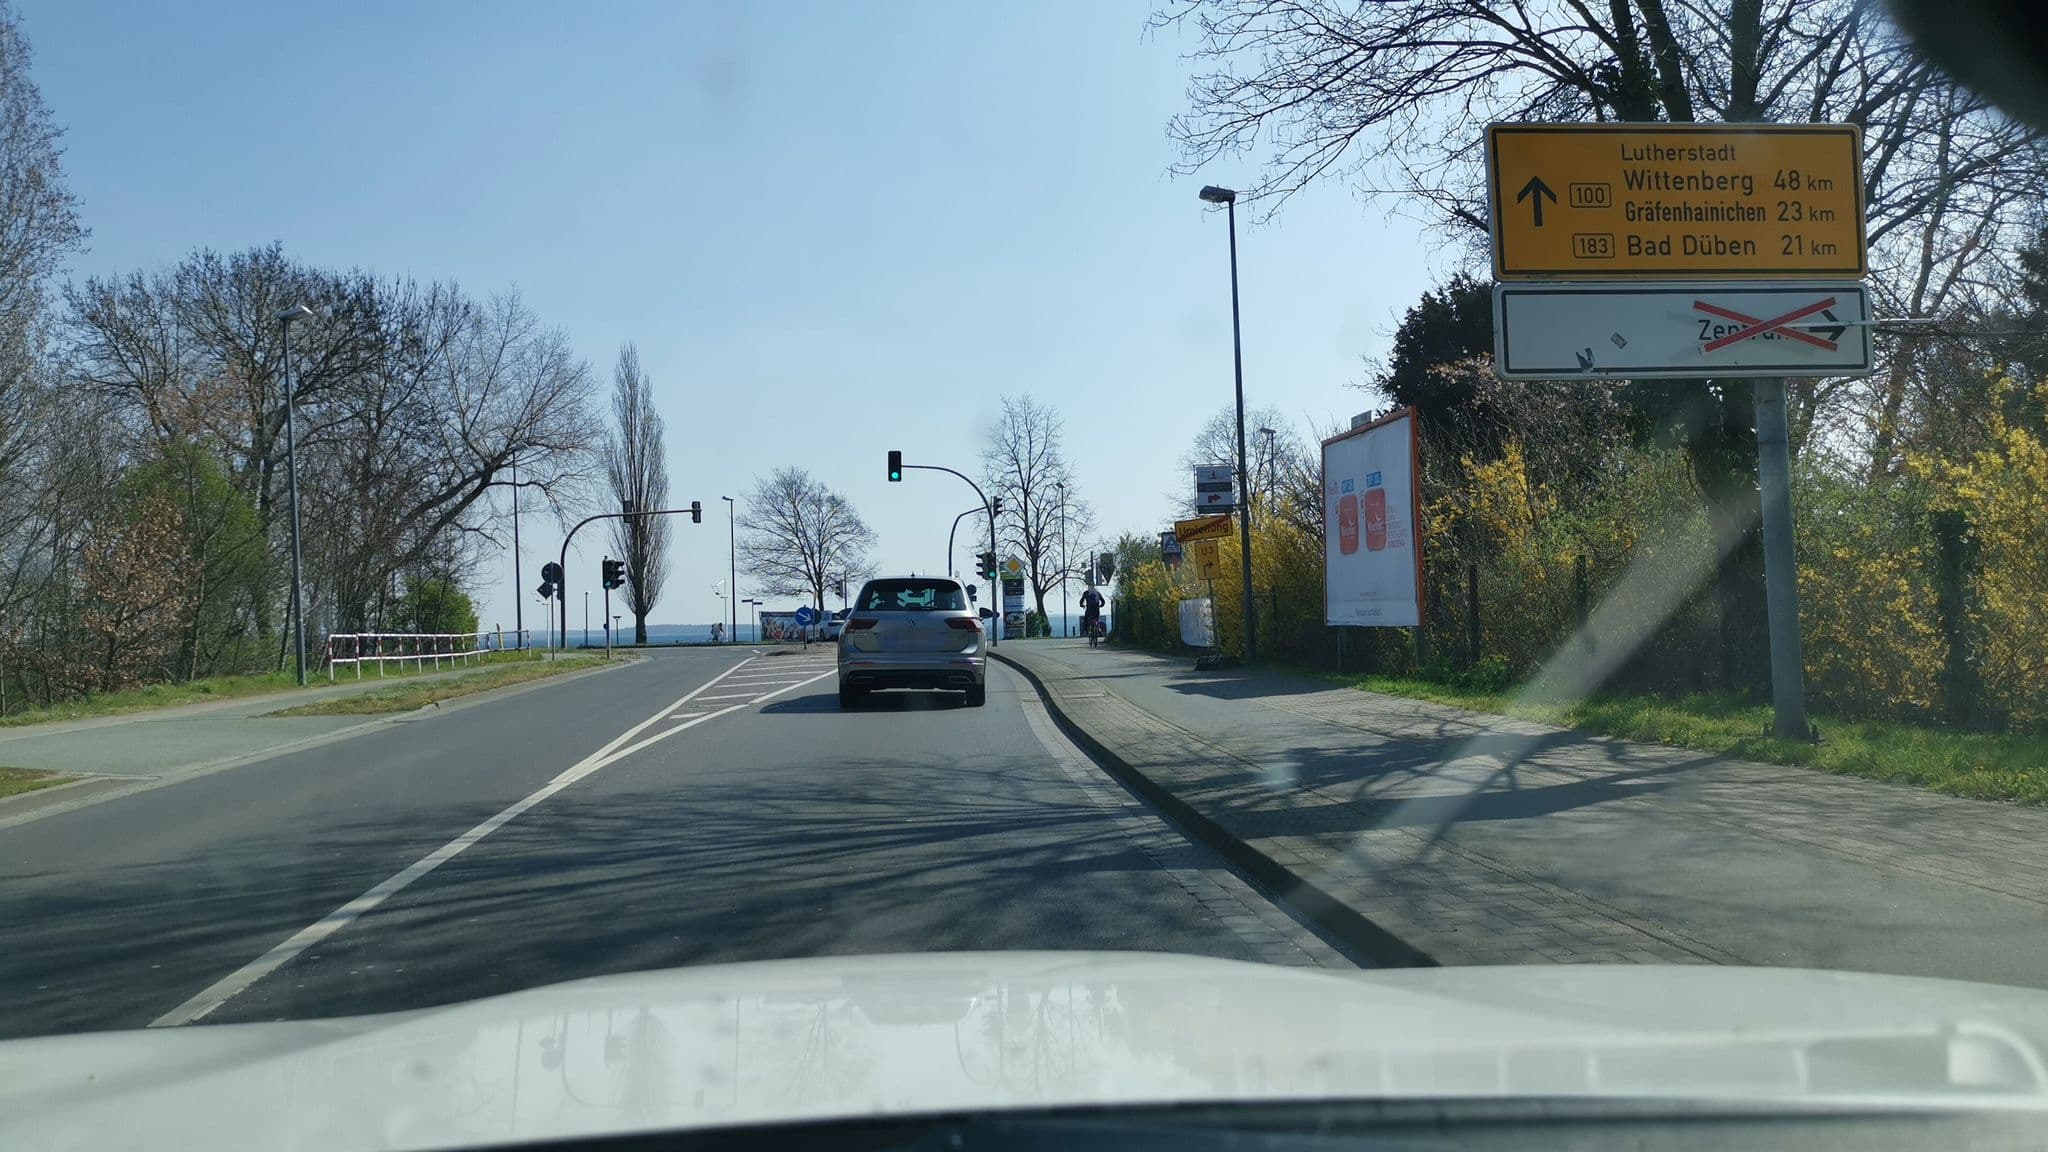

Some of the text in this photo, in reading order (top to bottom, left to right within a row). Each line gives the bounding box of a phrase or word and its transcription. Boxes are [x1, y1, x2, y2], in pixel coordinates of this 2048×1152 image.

[1621, 143, 1736, 161] Lutherstadt
[1623, 169, 1833, 196] Wittenberg 48 km
[1575, 187, 1605, 204] 100
[1625, 200, 1835, 222] Gräfenhainichen 23 km
[1580, 234, 1837, 256] 183 Bad Düben 21 km
